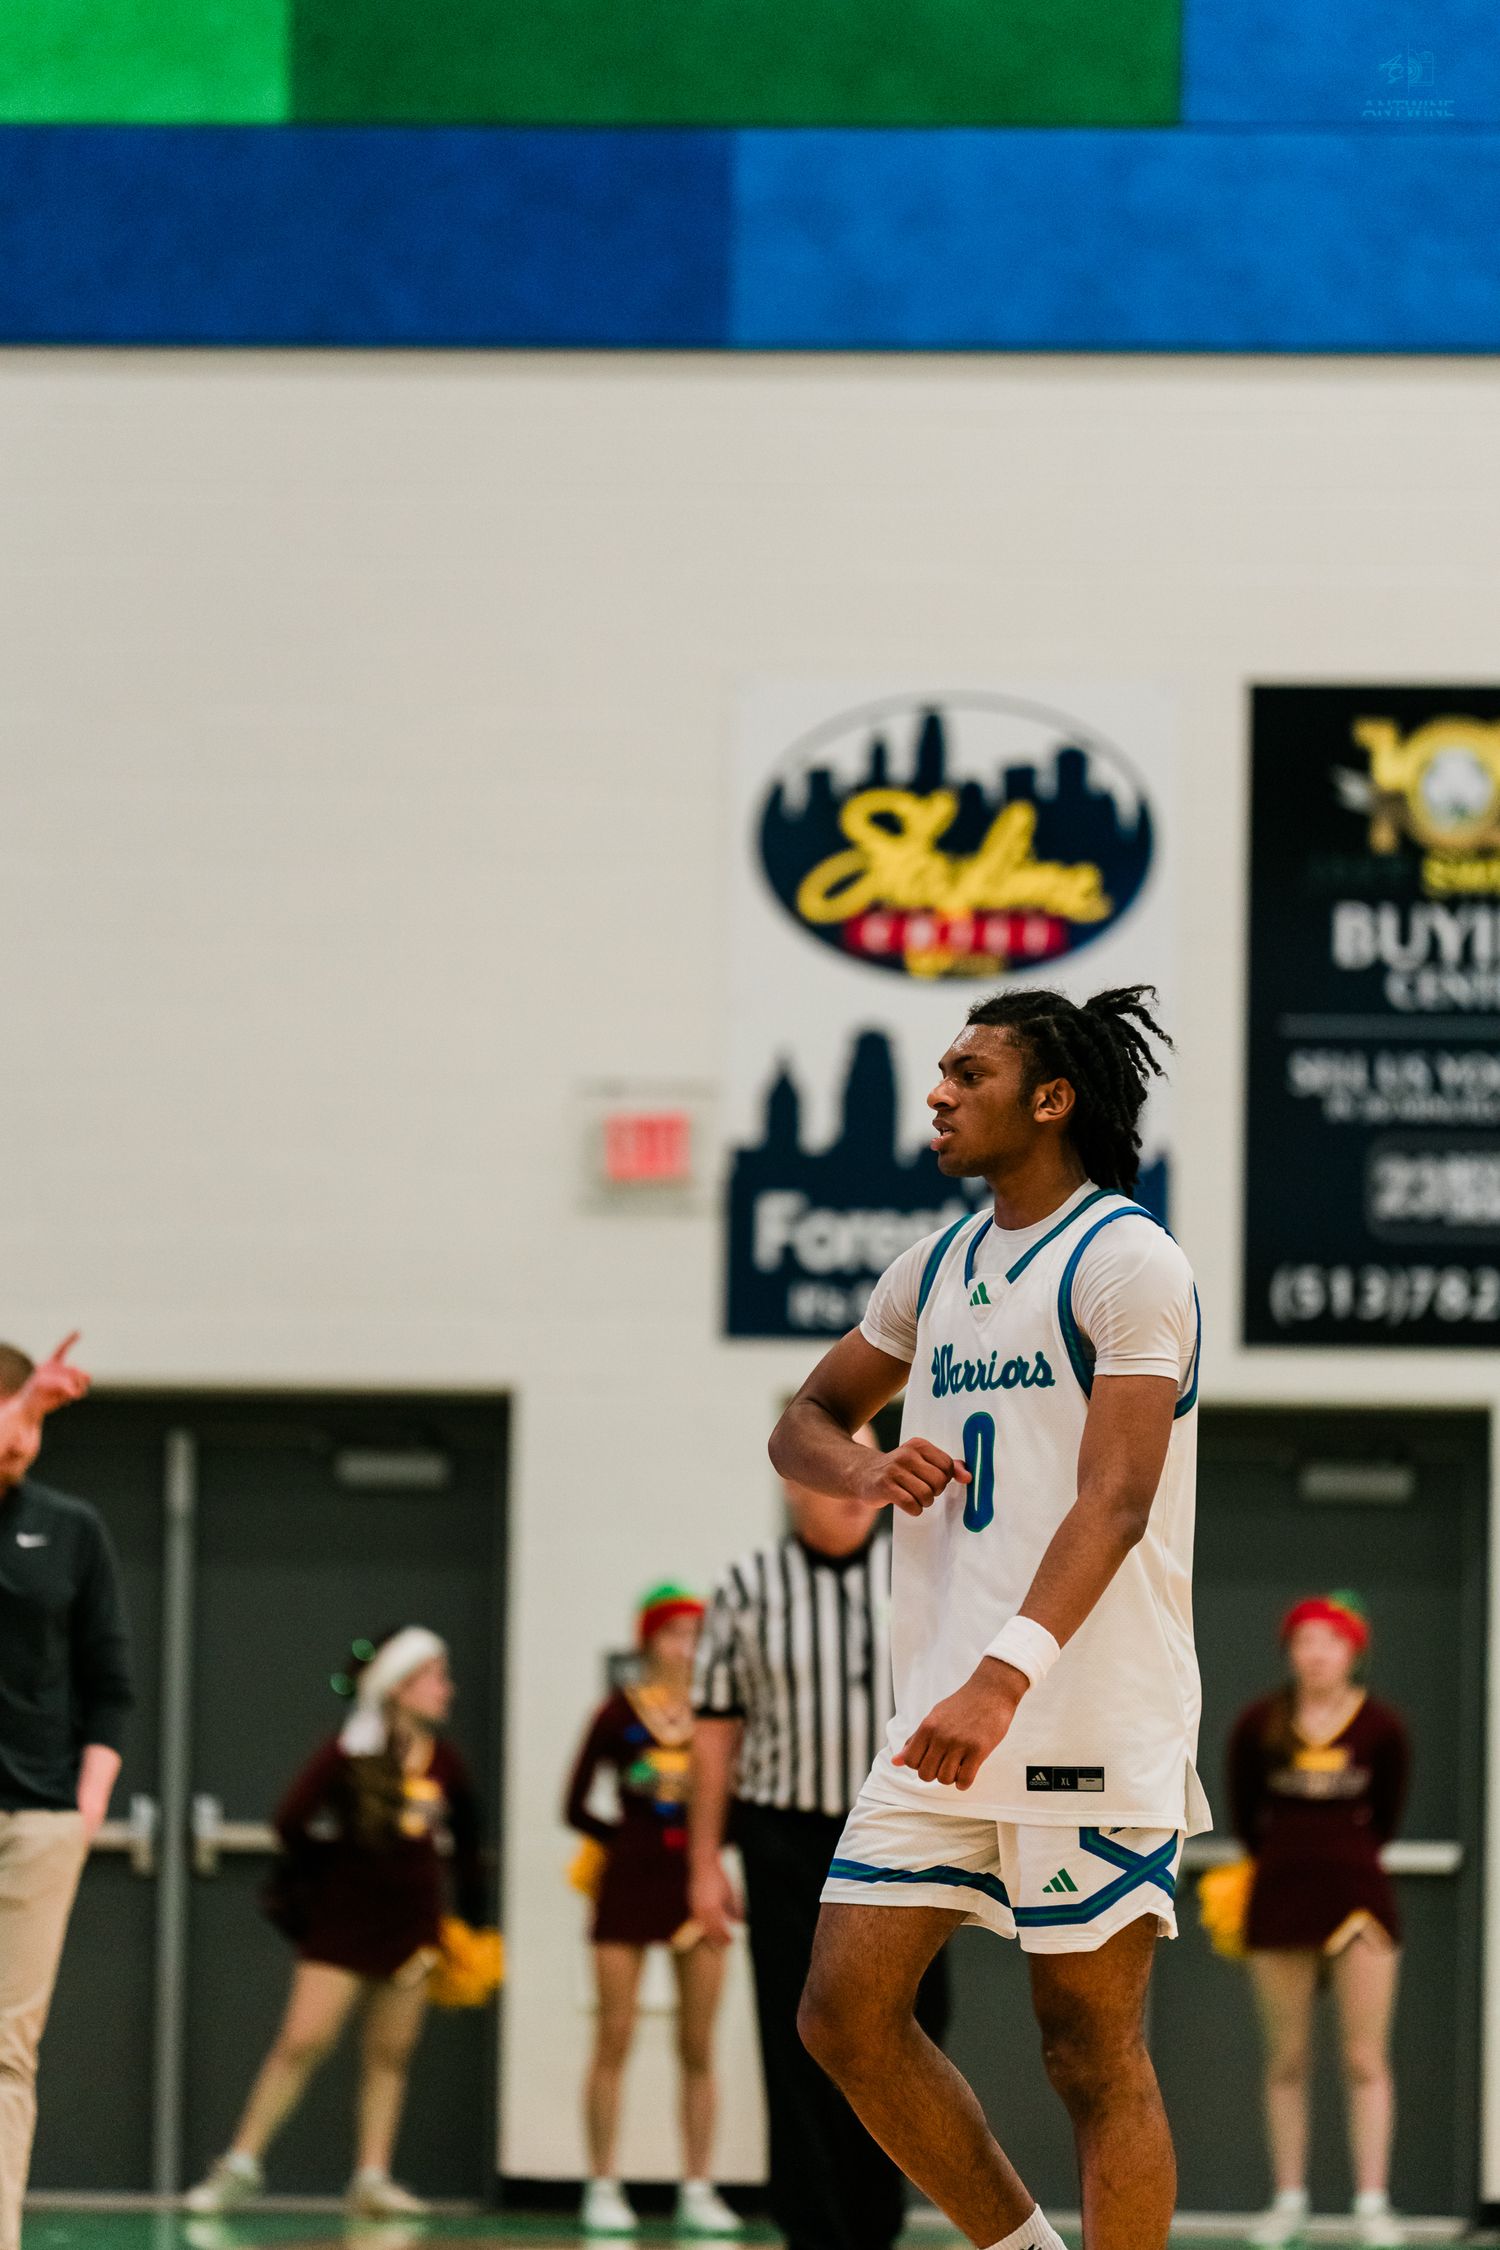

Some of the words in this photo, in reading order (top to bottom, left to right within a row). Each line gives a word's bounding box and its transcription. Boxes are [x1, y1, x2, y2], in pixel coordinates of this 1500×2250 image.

[1333, 902, 1500, 969] BUYI
[932, 1343, 1056, 1399] Warriors
[963, 1411, 995, 1533] 0
[1061, 1777, 1070, 1786] XL
